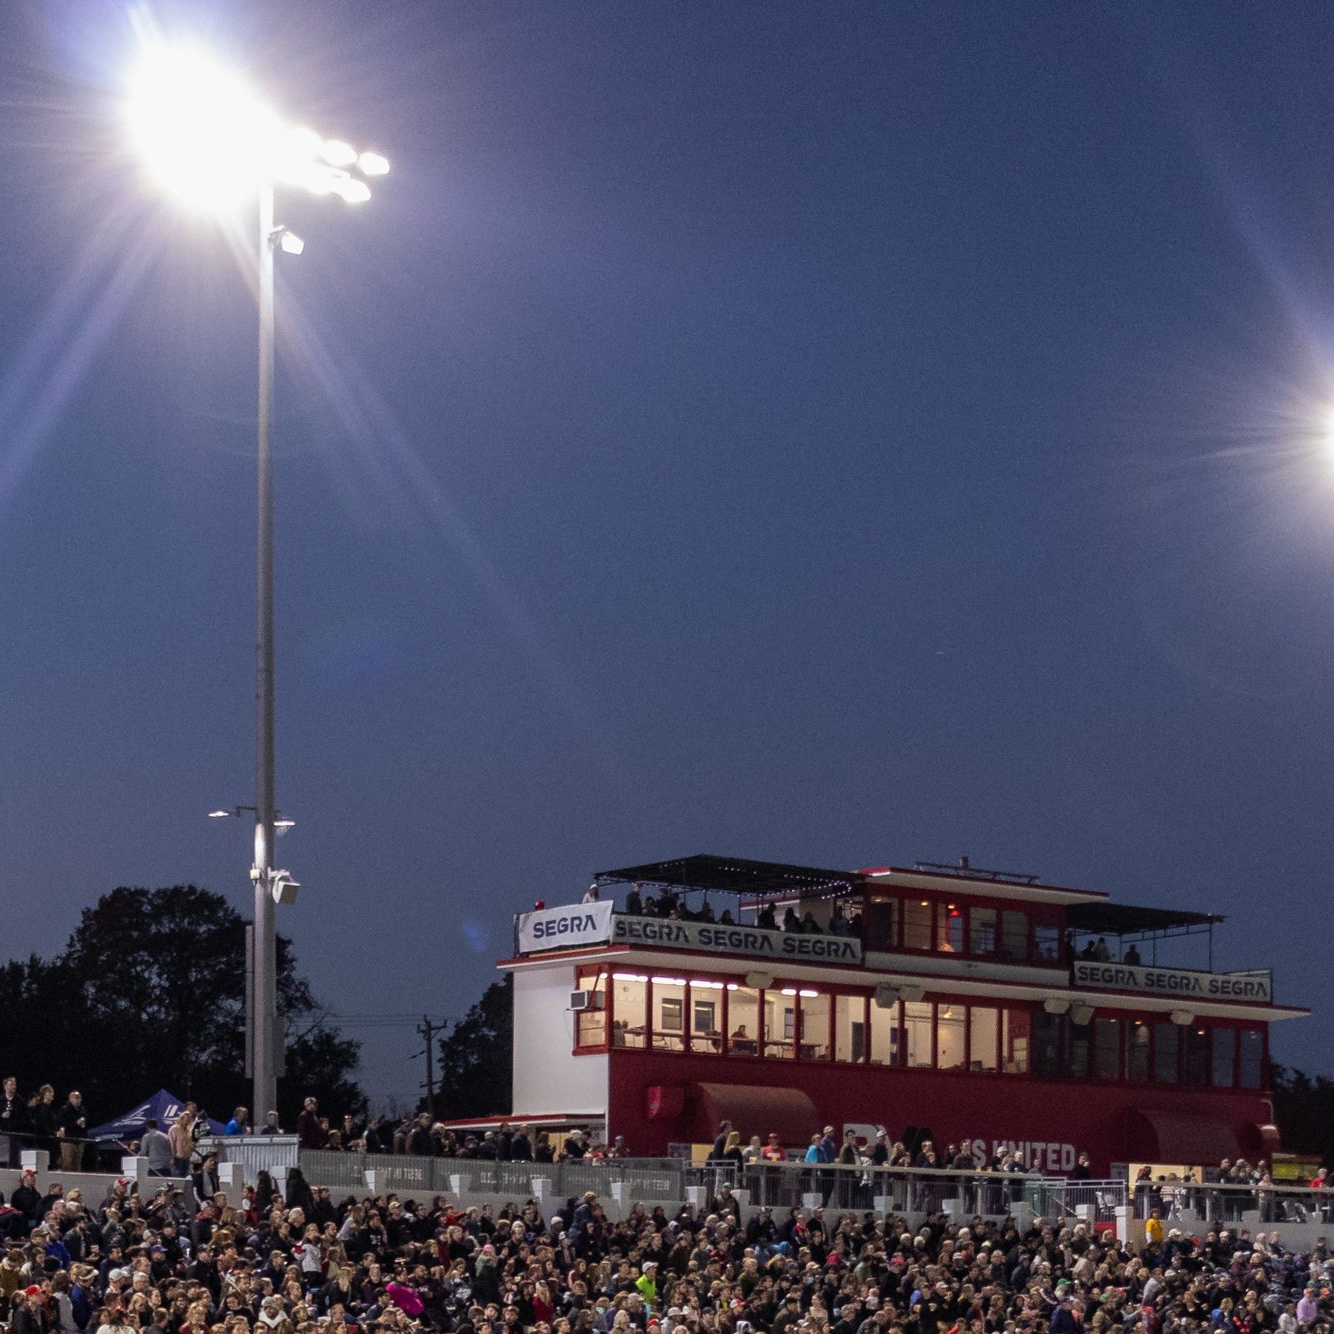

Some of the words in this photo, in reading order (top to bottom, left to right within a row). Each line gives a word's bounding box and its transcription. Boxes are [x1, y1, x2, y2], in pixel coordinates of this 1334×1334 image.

[533, 914, 597, 939] SEGRA
[615, 920, 690, 943] SEGRA
[698, 928, 772, 951] SEGRA
[782, 938, 856, 959] SEGRA
[1077, 965, 1138, 987] SEGRA
[1144, 972, 1202, 992] SEGRA
[1208, 978, 1267, 997] SEGRA
